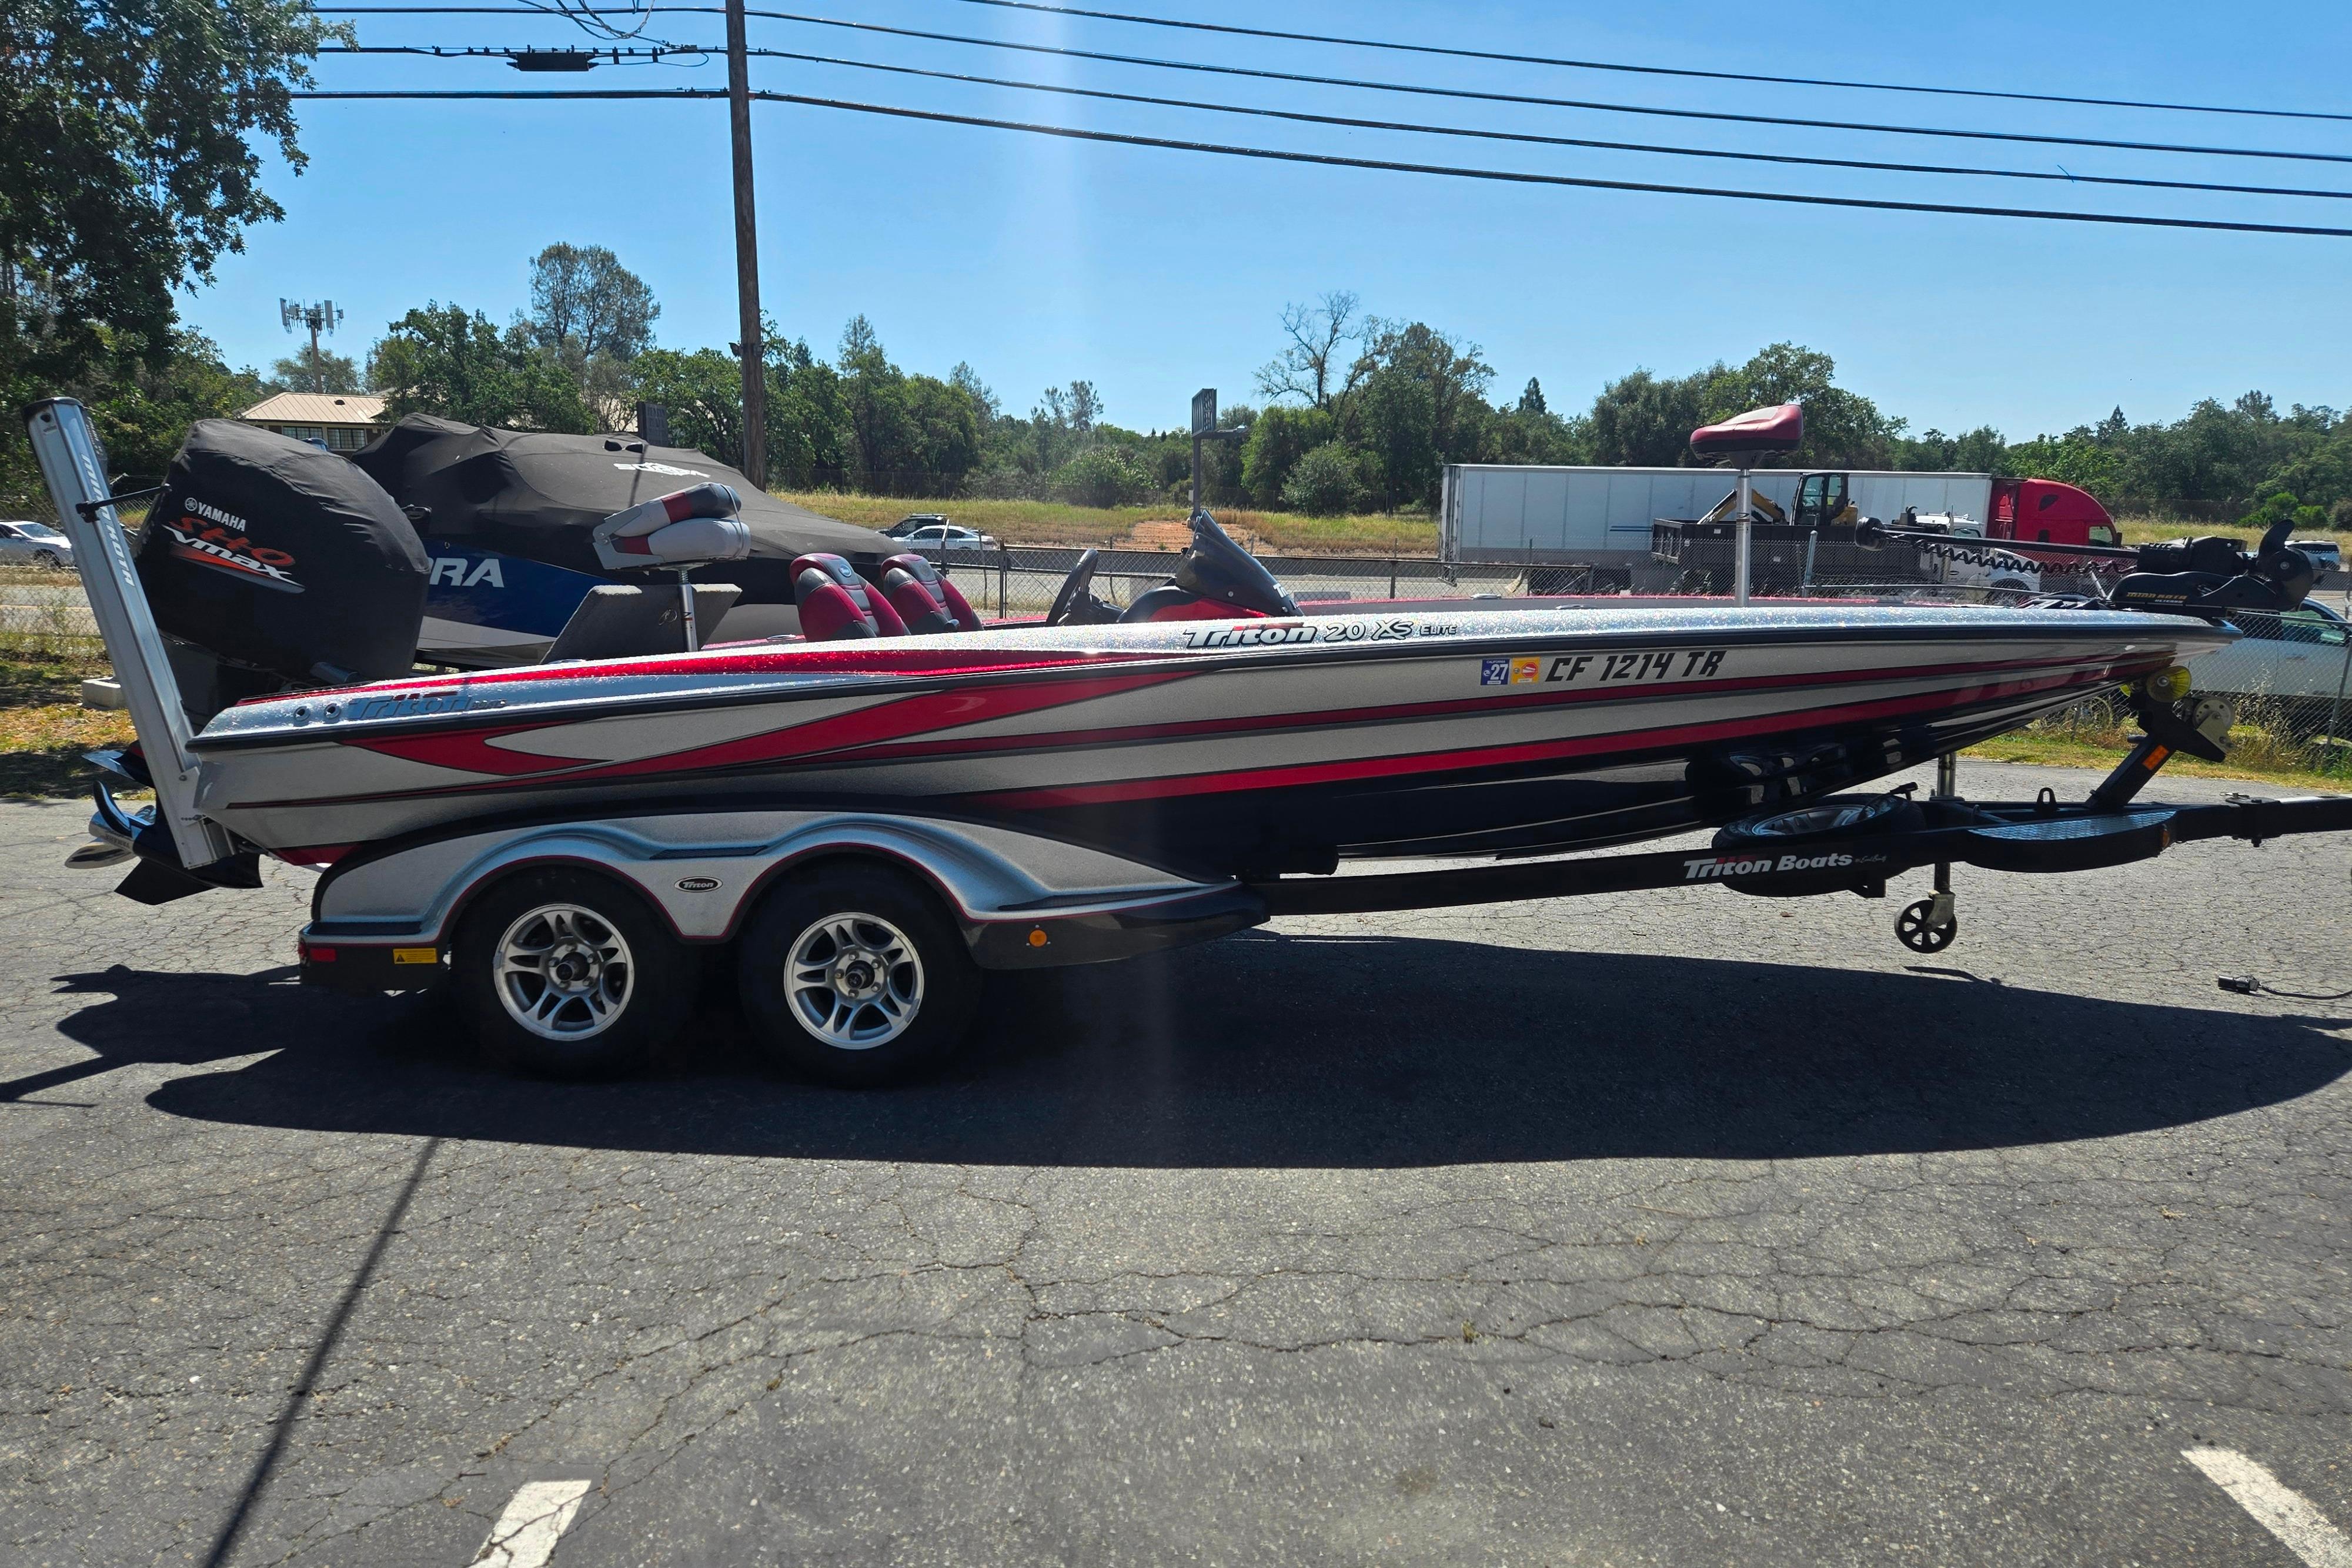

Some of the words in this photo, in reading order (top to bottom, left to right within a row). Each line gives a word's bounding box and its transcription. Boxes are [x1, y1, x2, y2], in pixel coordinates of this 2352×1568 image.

[198, 502, 246, 531] YAMAHA
[169, 517, 296, 567] SHO
[427, 557, 505, 588] RA
[1183, 626, 1318, 649] Triton
[1324, 621, 1367, 642] 20
[1371, 618, 1414, 641] XS
[1419, 624, 1458, 636] ELITE
[1490, 664, 1509, 680] 27
[1545, 656, 1594, 683] CF
[1599, 652, 1676, 681] 1214
[1681, 650, 1728, 677] TR
[348, 694, 471, 720] Triton
[1683, 857, 1773, 880] Triton
[1776, 852, 1853, 872] Boats
